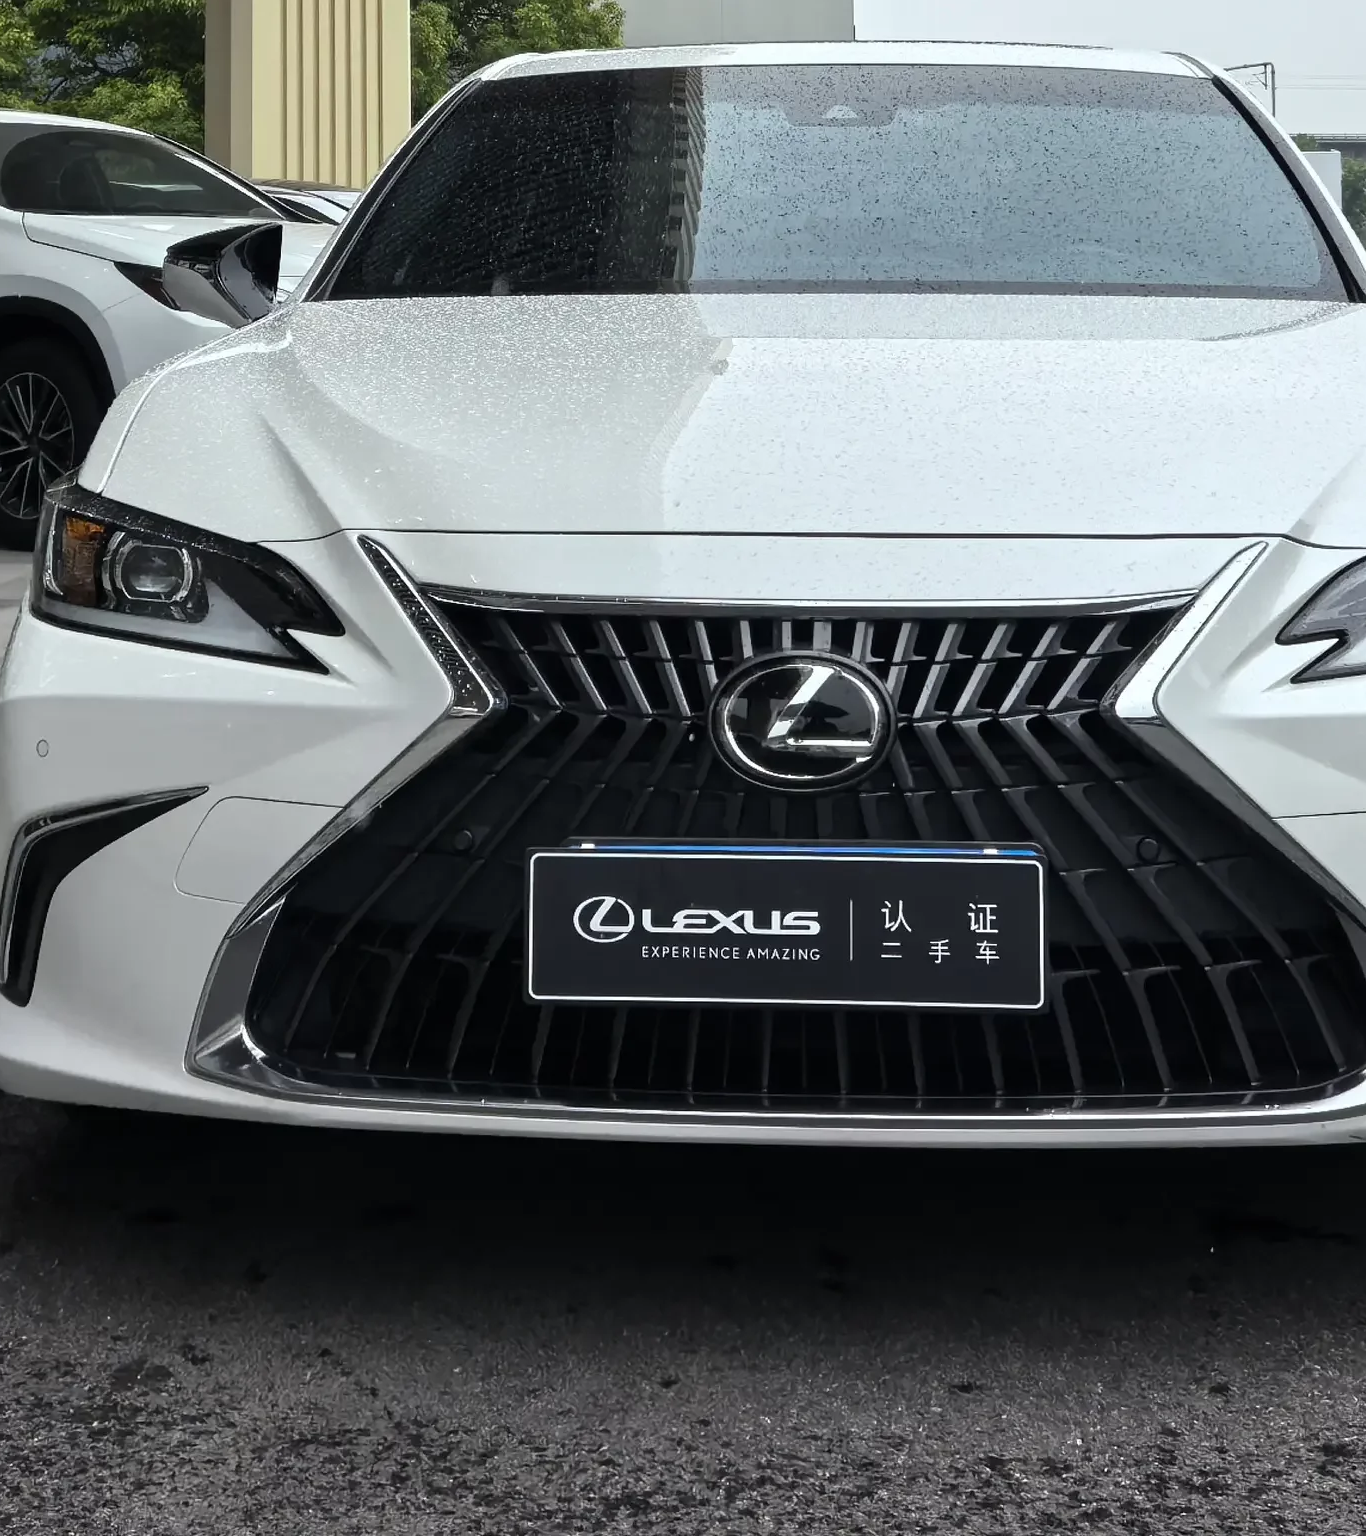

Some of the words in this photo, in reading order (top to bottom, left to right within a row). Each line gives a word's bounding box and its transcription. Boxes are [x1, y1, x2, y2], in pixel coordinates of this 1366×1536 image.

[642, 909, 821, 935] LEXUS
[641, 945, 740, 960] EXPERIENCE
[746, 948, 821, 961] AMAZING
